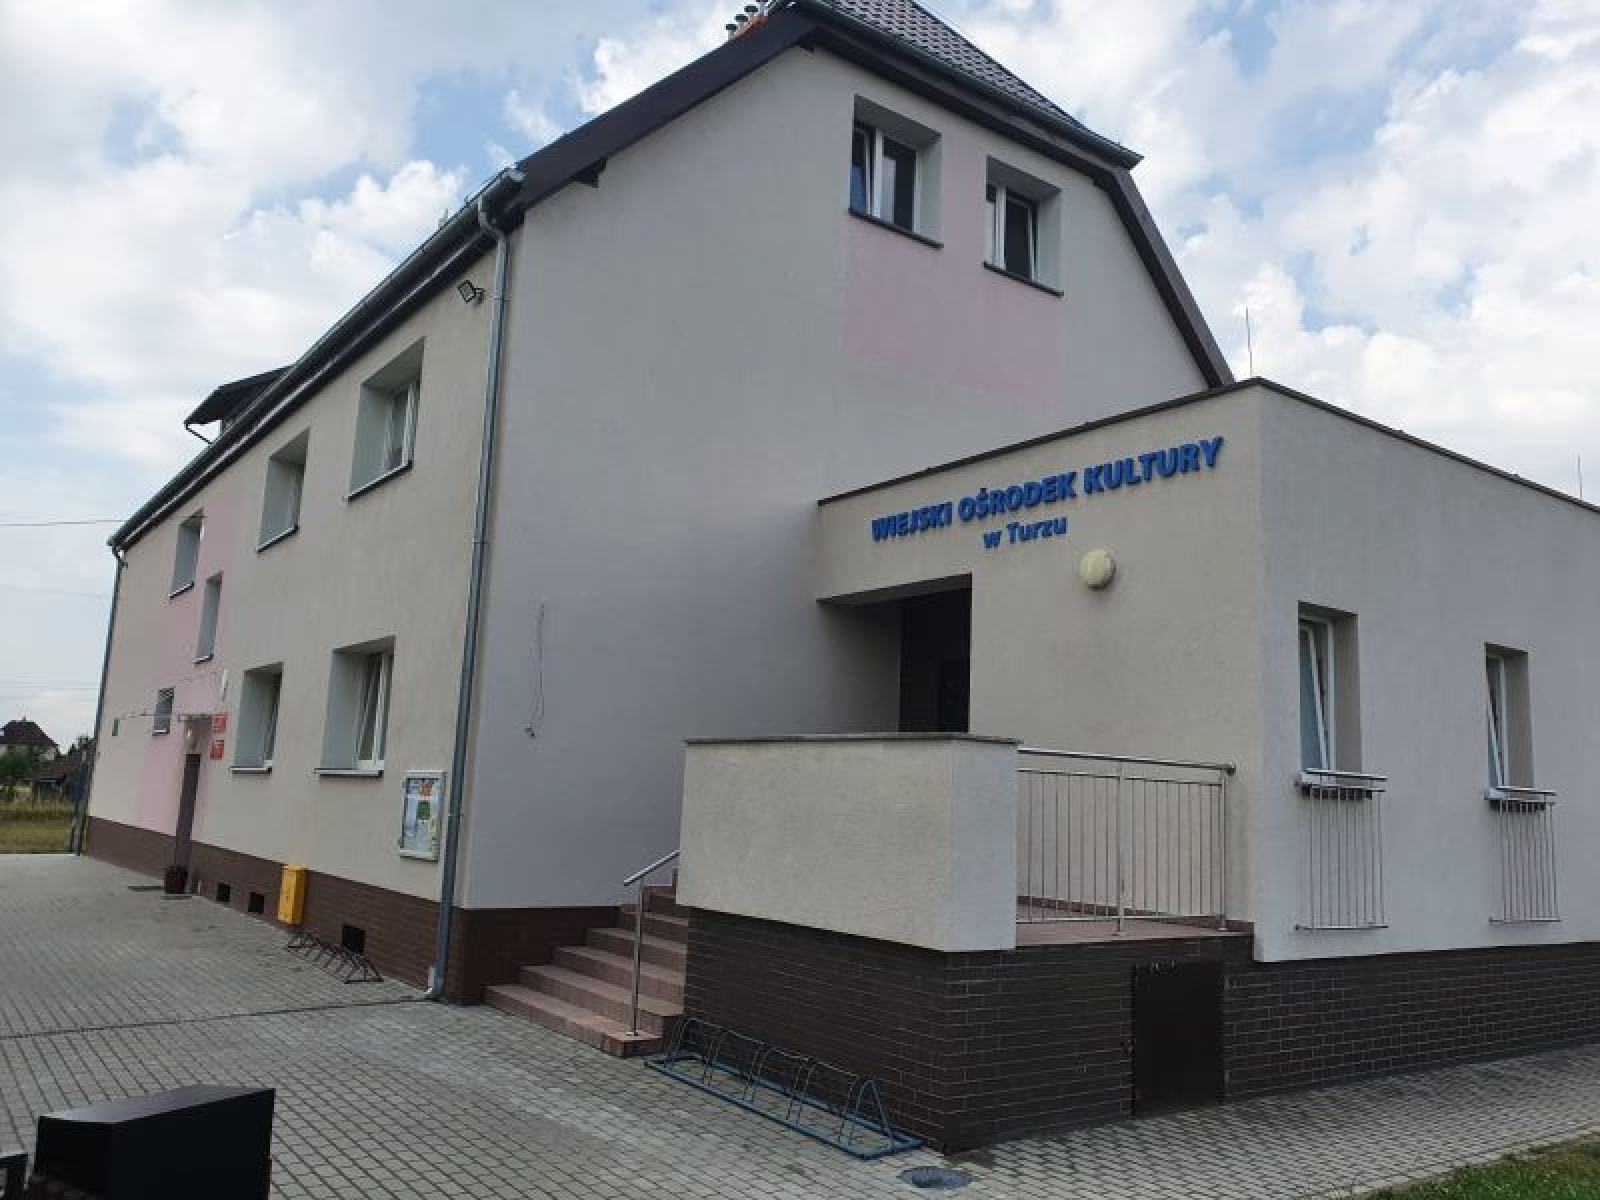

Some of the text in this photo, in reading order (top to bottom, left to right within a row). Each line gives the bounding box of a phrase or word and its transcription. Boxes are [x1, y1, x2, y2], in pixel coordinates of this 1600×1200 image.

[871, 436, 1224, 542] WIEJSKI OŚRODEK KULTURY
[983, 517, 1067, 549] w Turzu
